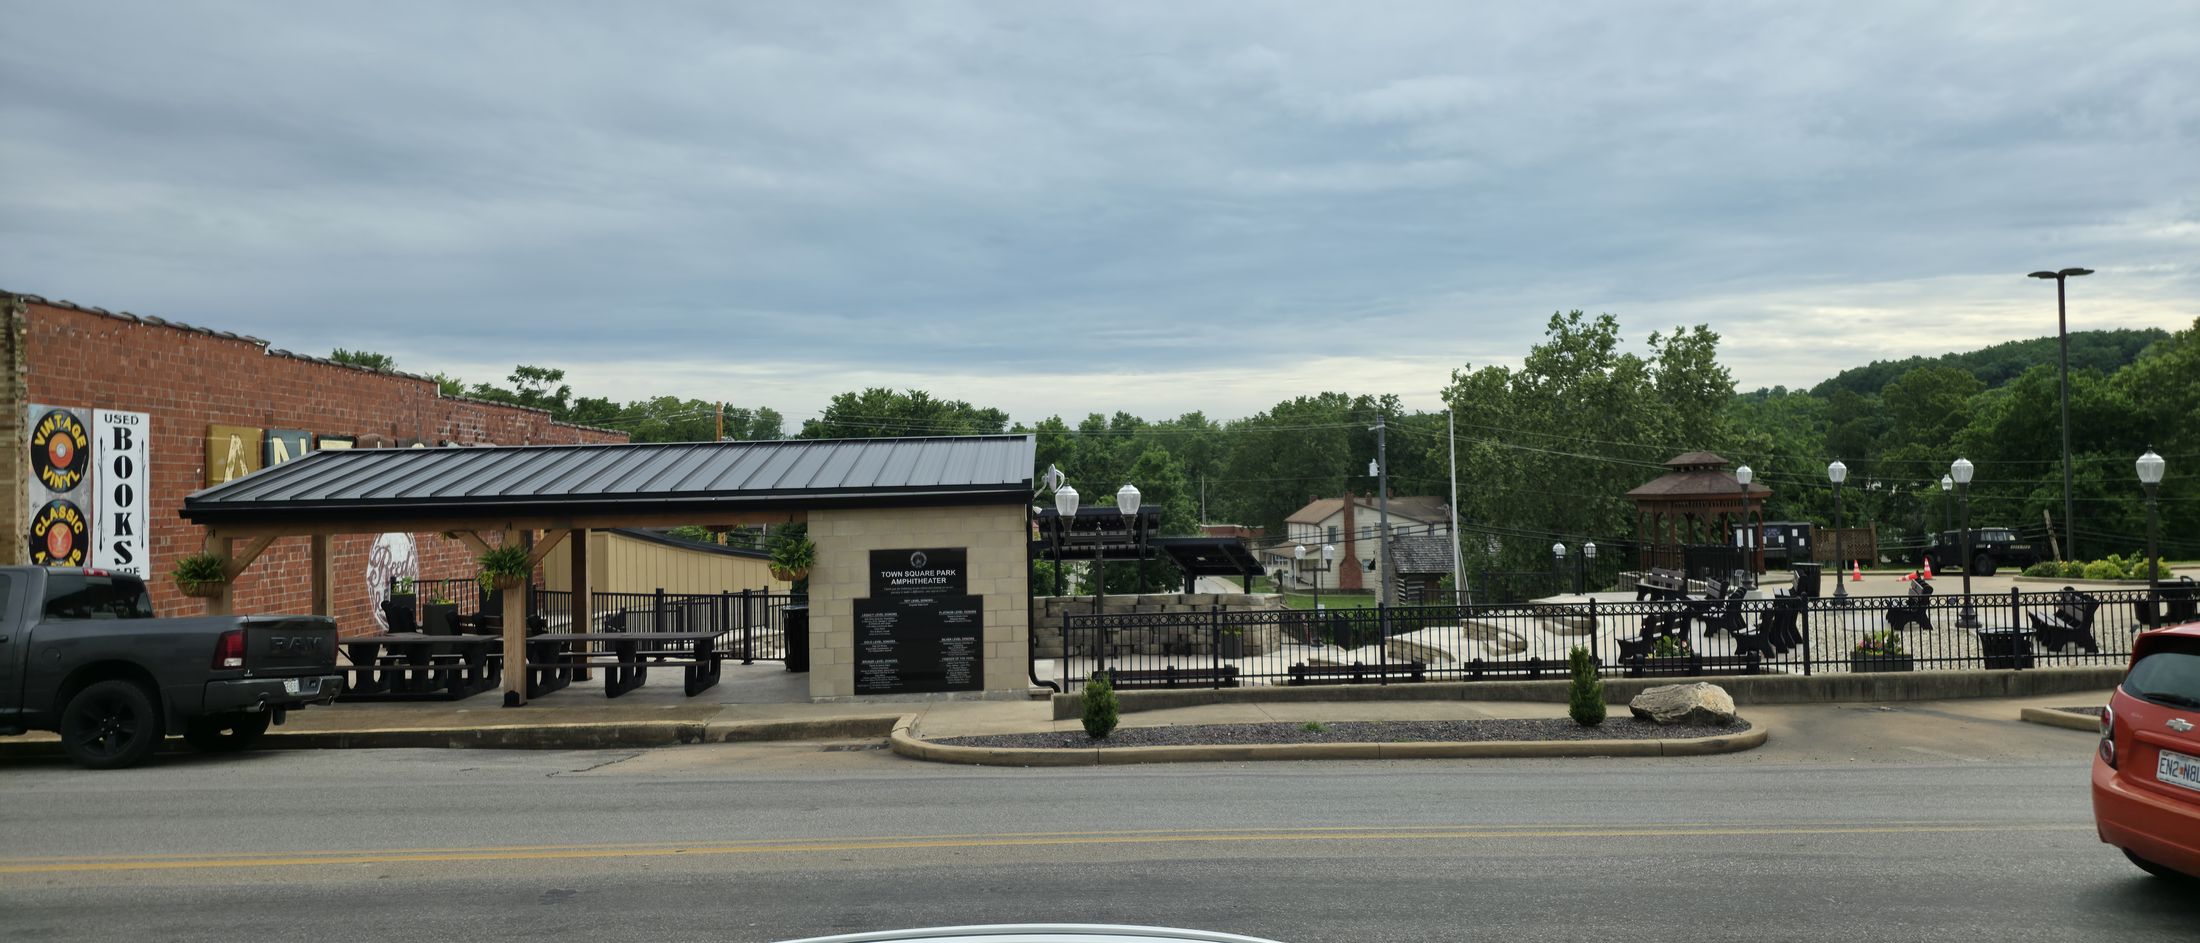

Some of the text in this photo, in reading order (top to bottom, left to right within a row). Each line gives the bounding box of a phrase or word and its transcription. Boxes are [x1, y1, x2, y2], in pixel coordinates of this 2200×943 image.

[104, 413, 139, 425] USED
[34, 413, 87, 450] VINTAGE
[42, 464, 80, 489] VINYL
[113, 427, 134, 566] BOOKS
[35, 504, 83, 535] CLASSIC
[890, 577, 947, 585] AMPHITHEATER
[904, 569, 935, 578] SQUARE
[936, 569, 956, 577] PARK
[2159, 758, 2179, 777] EN2
